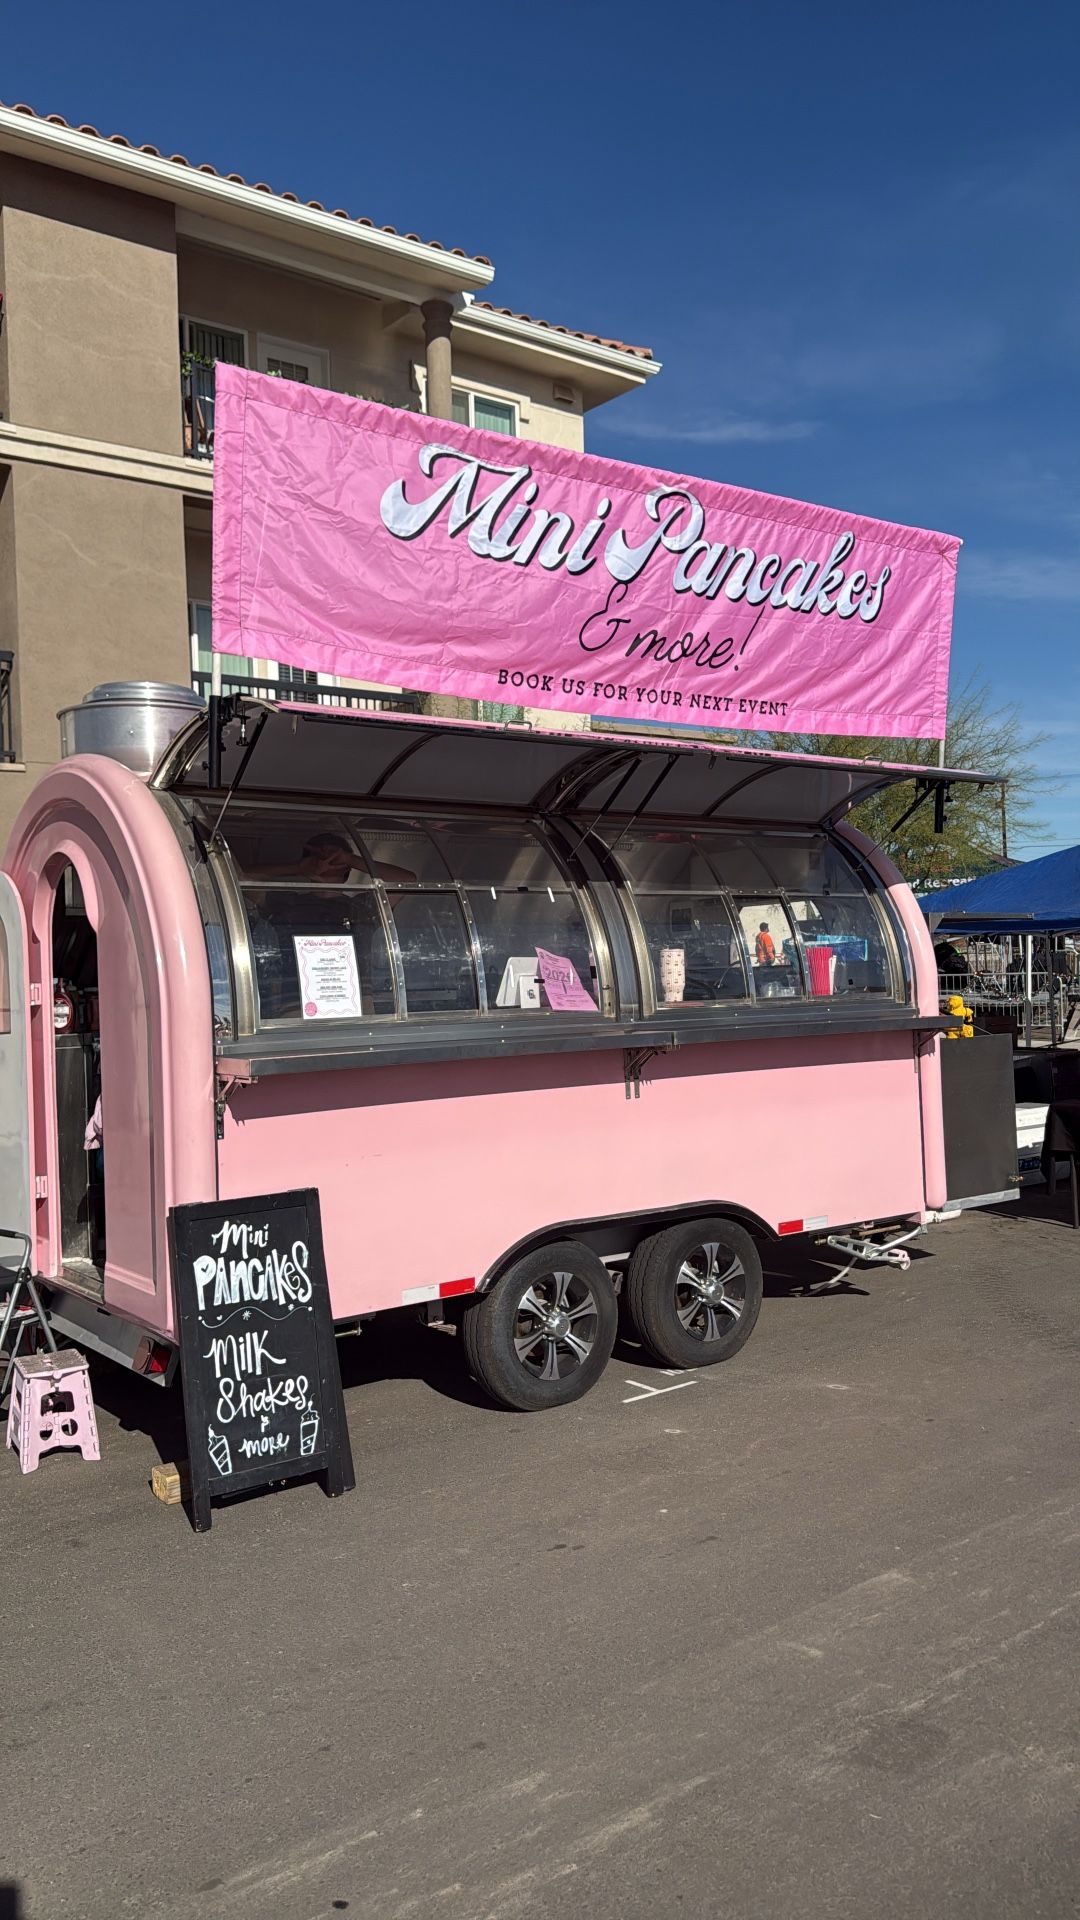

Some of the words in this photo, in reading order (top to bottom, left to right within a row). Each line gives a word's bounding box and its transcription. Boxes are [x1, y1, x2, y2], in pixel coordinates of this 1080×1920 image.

[380, 443, 612, 576] Mini
[604, 482, 891, 623] Pancakes
[578, 581, 631, 651] &
[625, 606, 765, 671] more!
[498, 669, 554, 692] BOOK
[562, 678, 586, 696] US
[593, 682, 628, 701] FOR
[636, 687, 682, 707] YOUR
[689, 694, 734, 711] NEXT
[738, 698, 788, 716] EVENT
[211, 1220, 269, 1260] Mini
